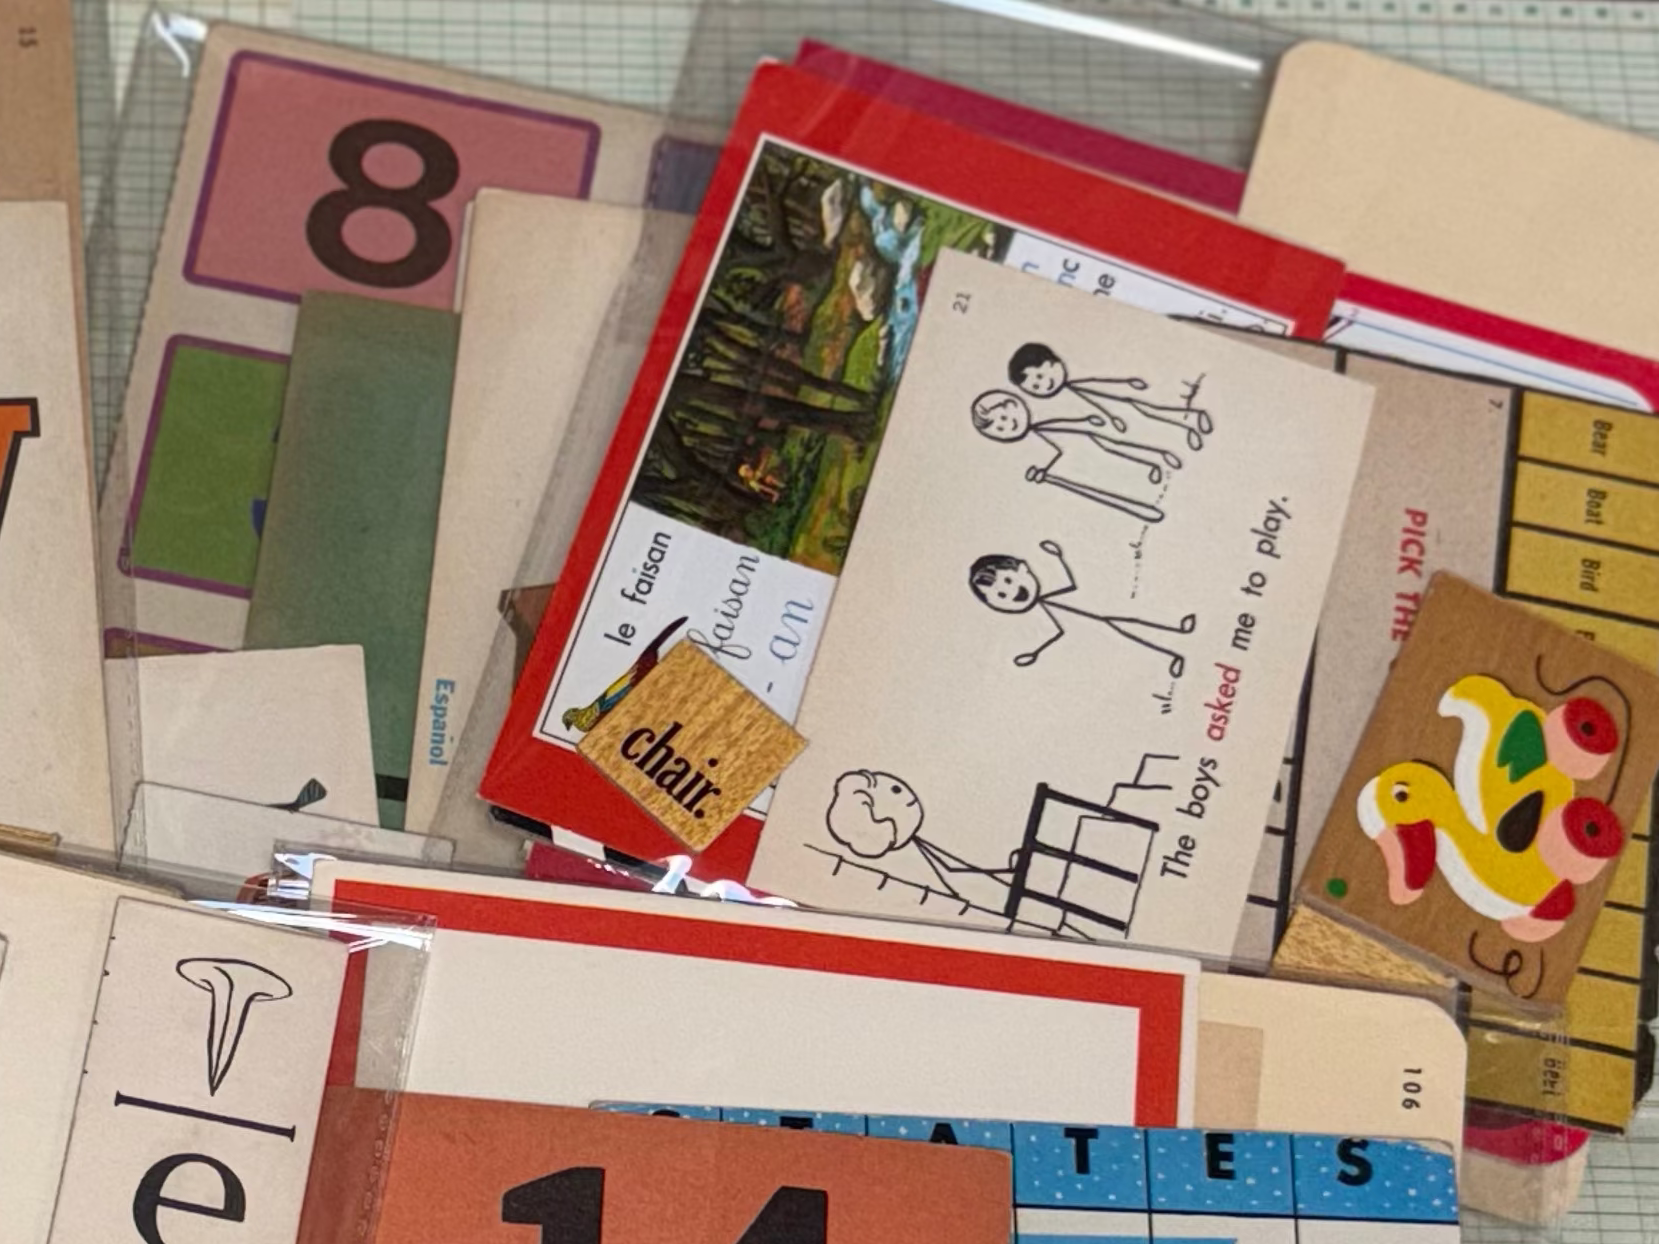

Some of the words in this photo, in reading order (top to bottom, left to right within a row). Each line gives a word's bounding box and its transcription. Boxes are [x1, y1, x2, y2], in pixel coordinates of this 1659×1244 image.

[305, 118, 460, 289] 8
[951, 290, 973, 315] 21
[1591, 418, 1614, 456] Bear
[1256, 495, 1291, 560] play.
[1585, 487, 1607, 526] Boat
[1397, 508, 1429, 579] PICK
[1579, 558, 1601, 593] Bird
[605, 619, 636, 648] le
[621, 531, 671, 604] faisan
[684, 554, 760, 661] faisan
[1240, 570, 1266, 599] to
[770, 596, 815, 664] an
[1232, 611, 1258, 650] me
[1389, 591, 1421, 643] THE
[429, 678, 455, 766] Español
[1205, 662, 1242, 742] asked
[620, 722, 723, 820] chair.
[1177, 755, 1221, 819] boys
[1160, 831, 1198, 880] The
[1401, 1067, 1423, 1110] 106
